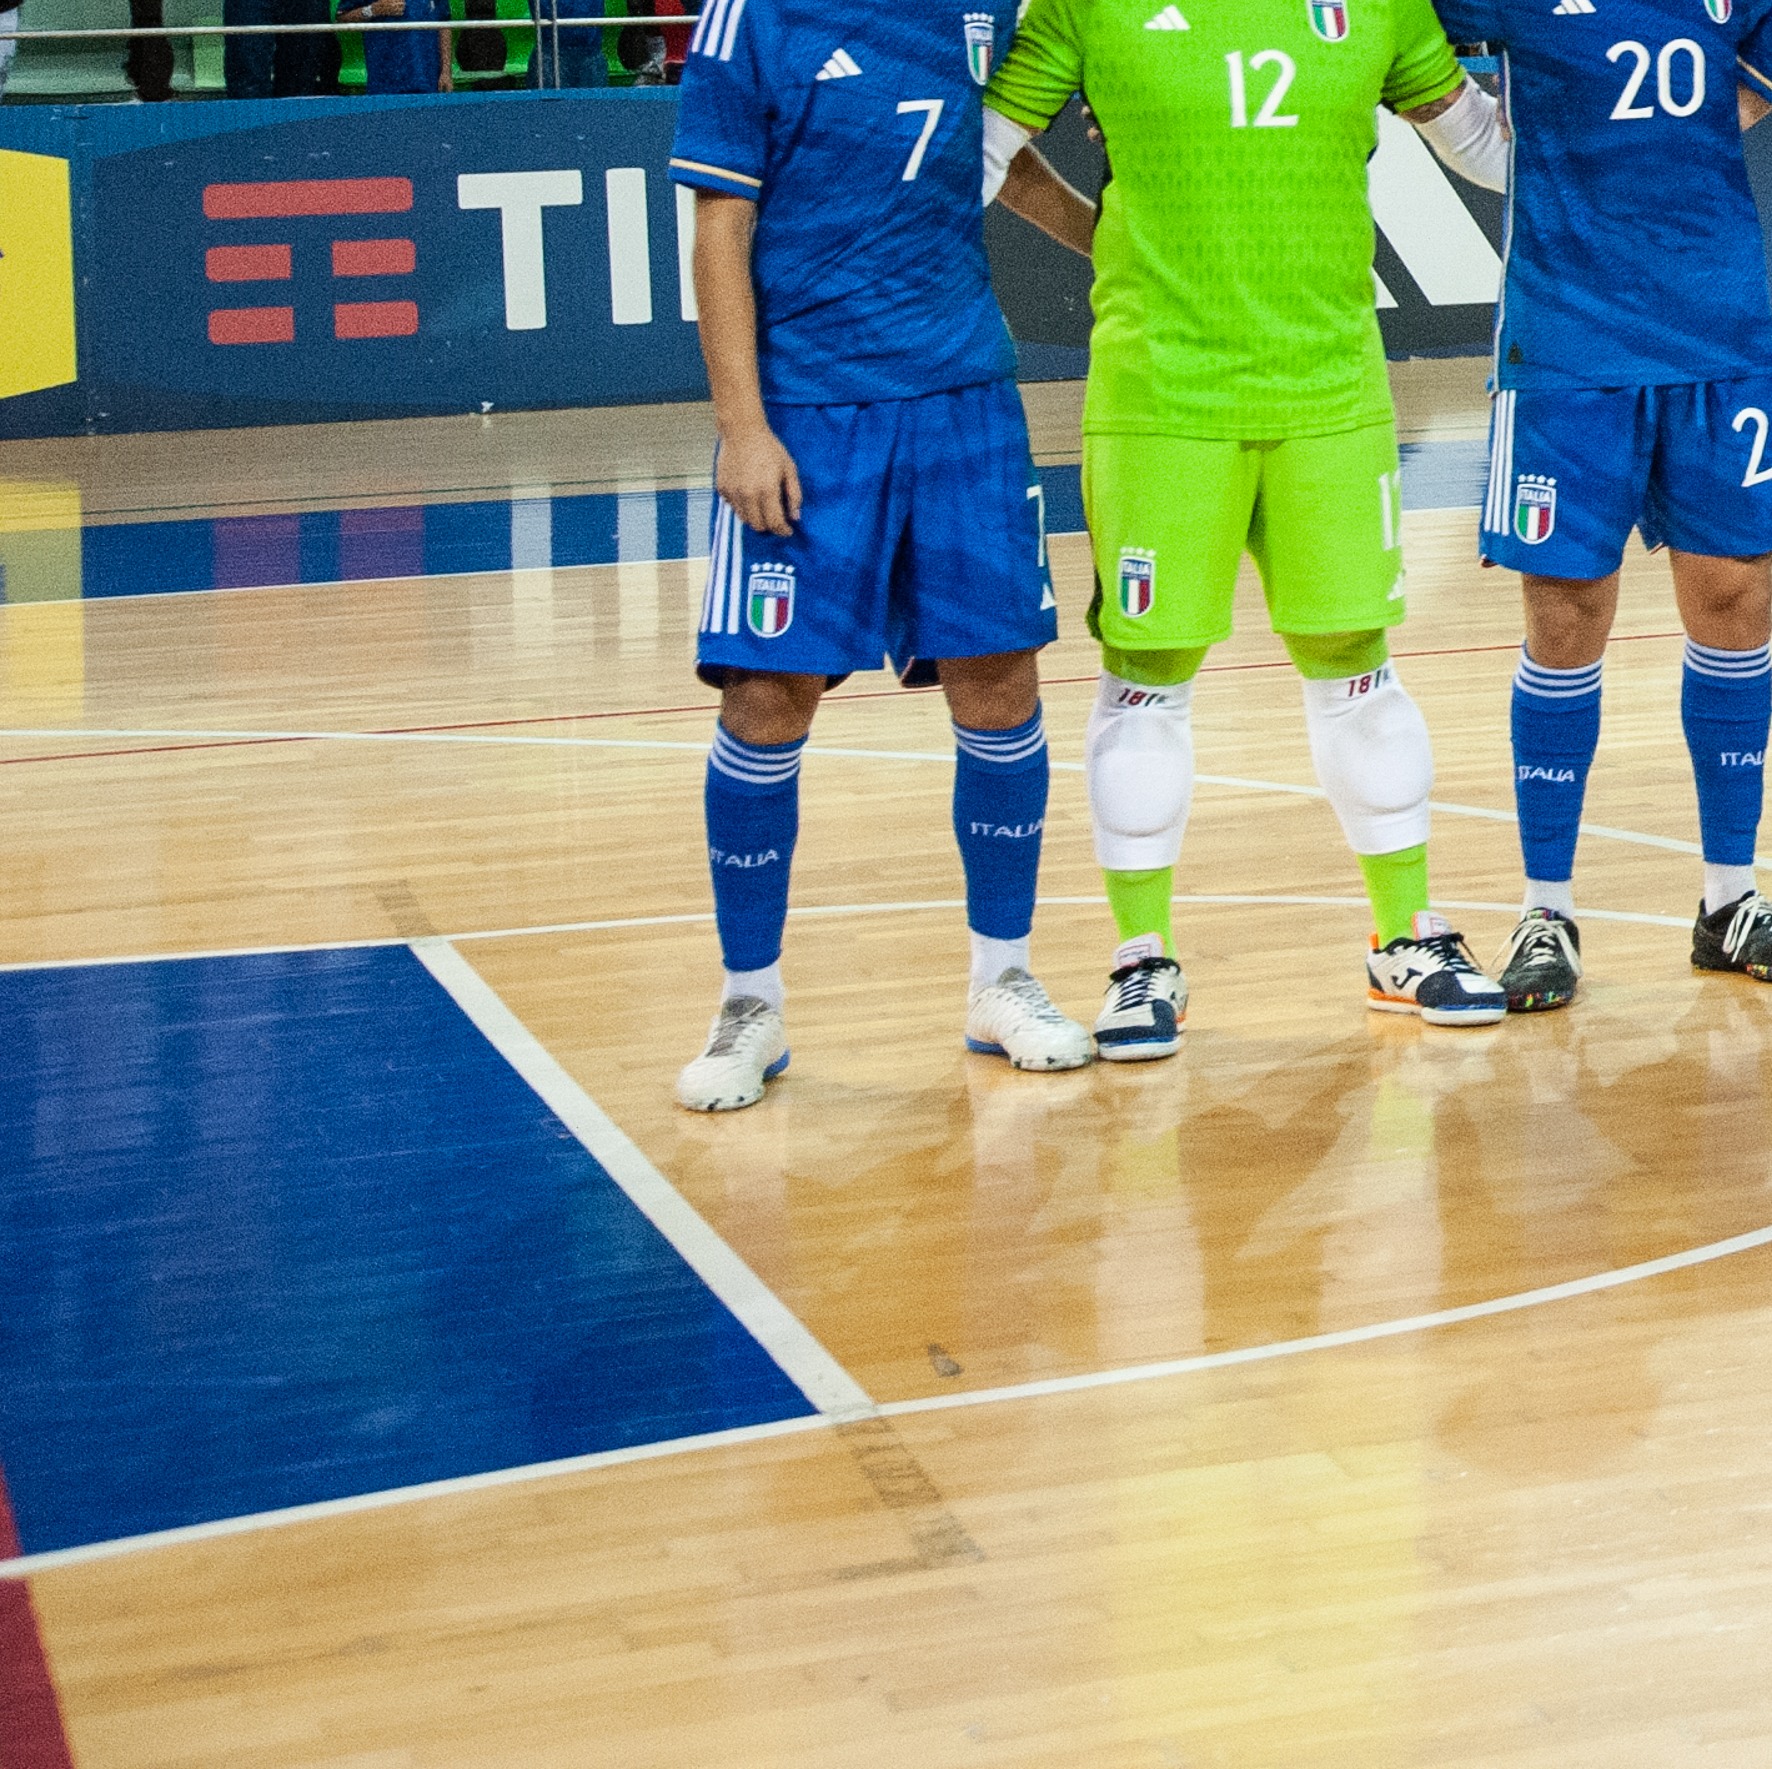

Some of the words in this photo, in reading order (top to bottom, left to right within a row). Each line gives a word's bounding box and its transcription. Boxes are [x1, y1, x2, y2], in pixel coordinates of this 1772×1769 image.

[1225, 49, 1299, 128] 12
[1606, 38, 1706, 121] 20
[896, 98, 945, 182] 7
[457, 166, 697, 330] TI
[1518, 487, 1553, 504] ITALIA
[1518, 764, 1575, 784] ITALIA
